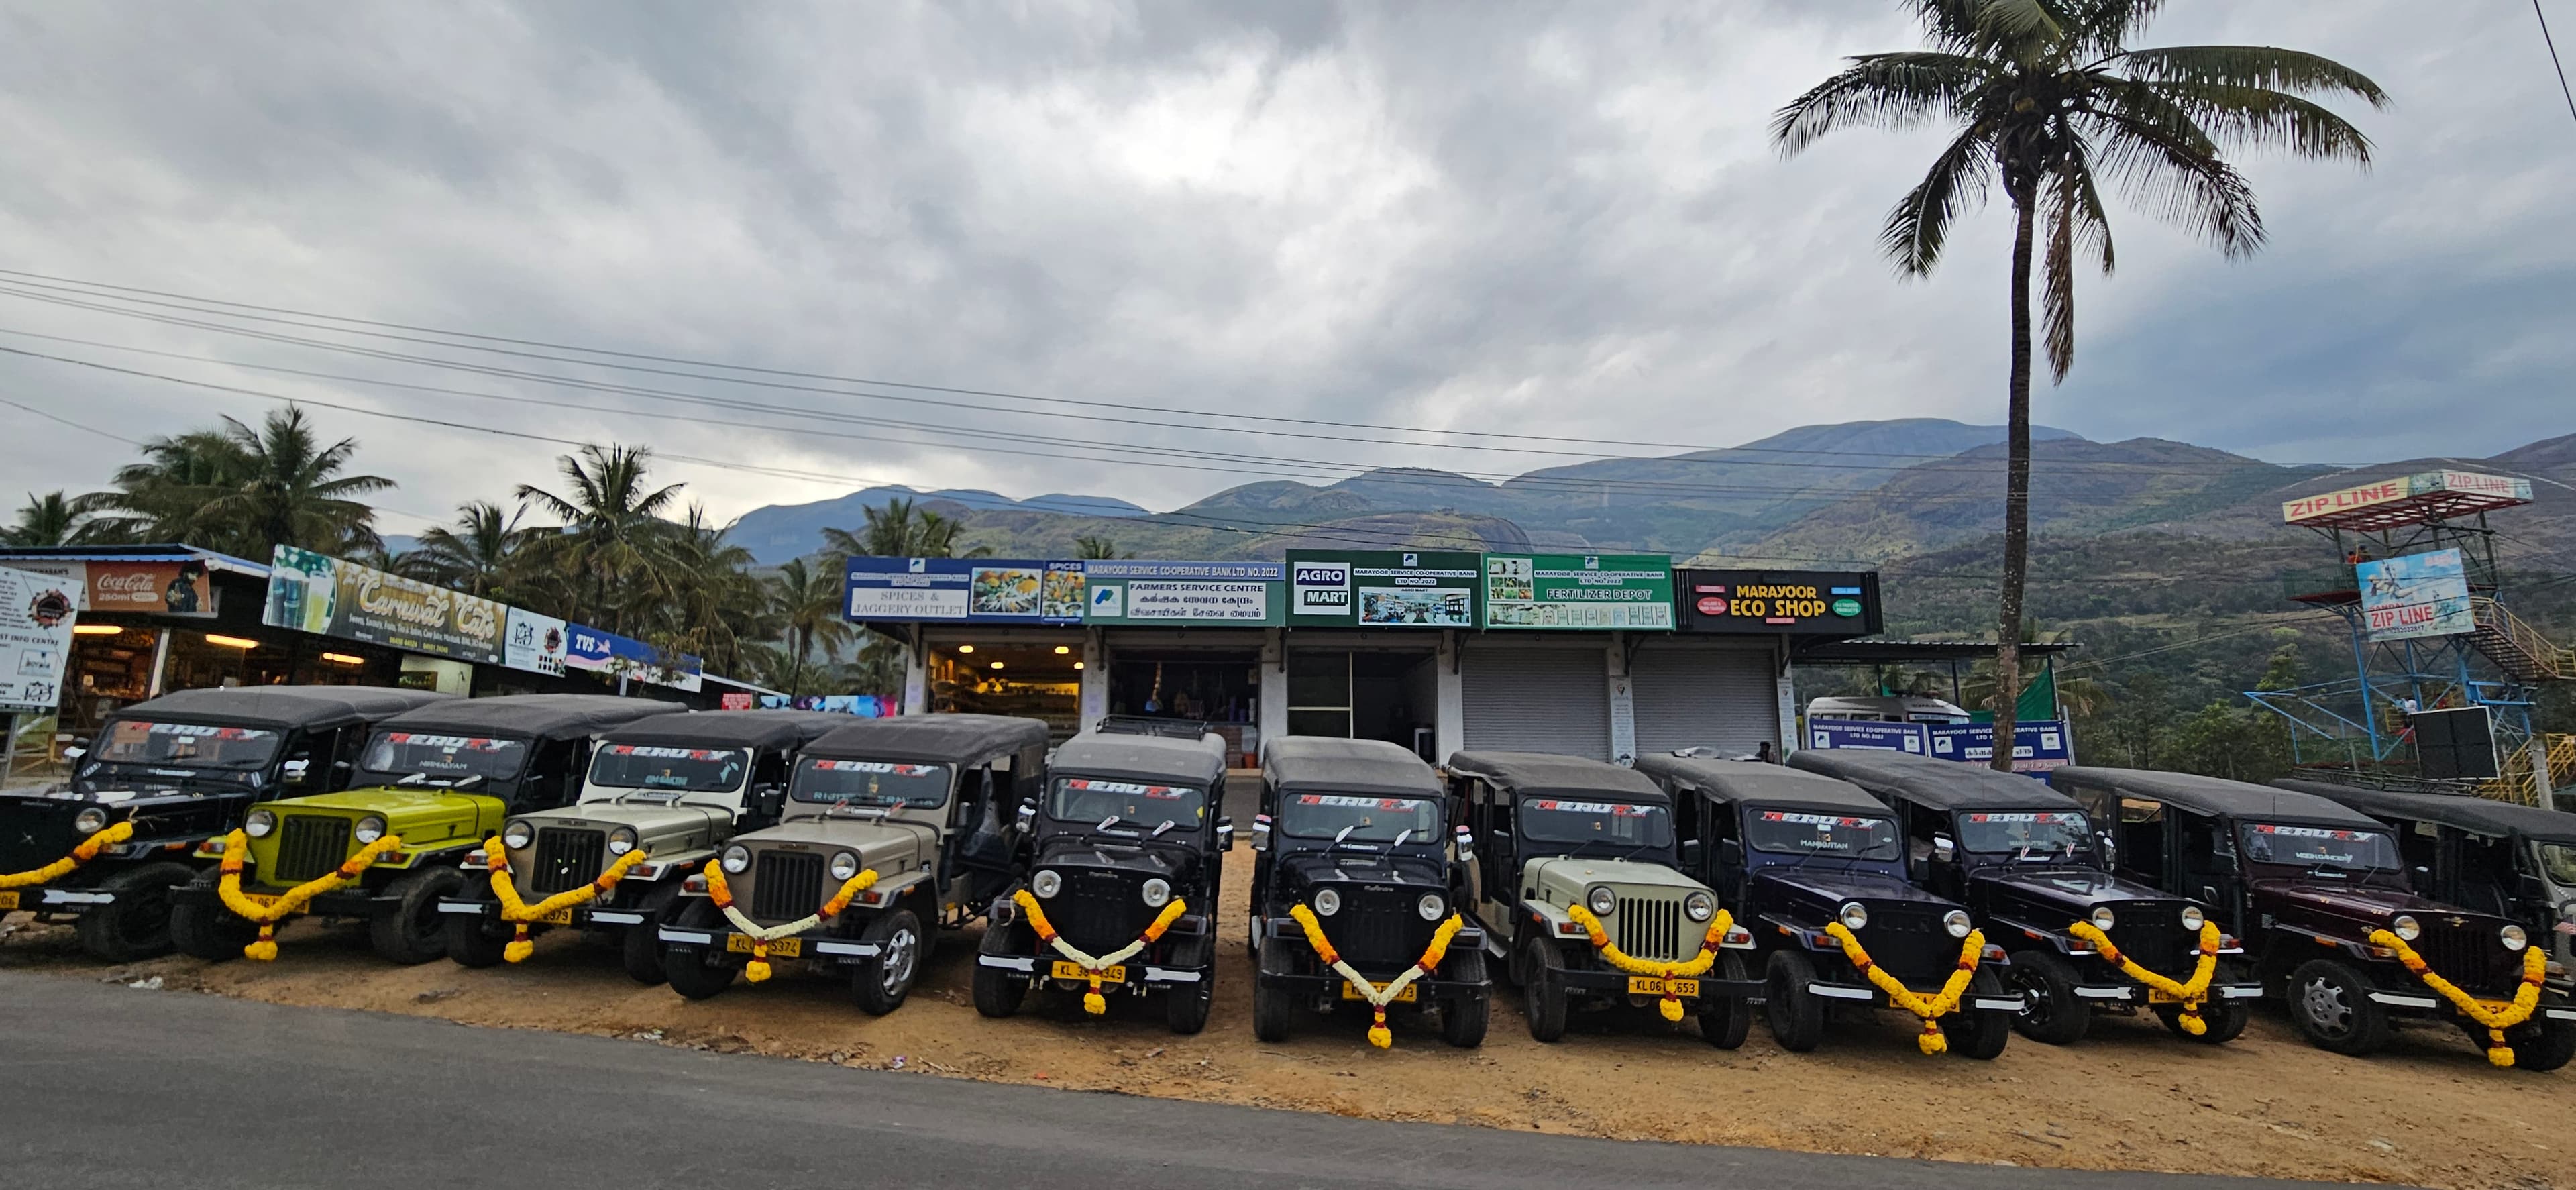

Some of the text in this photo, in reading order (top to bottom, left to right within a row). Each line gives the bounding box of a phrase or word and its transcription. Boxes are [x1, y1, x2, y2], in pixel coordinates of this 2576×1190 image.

[2448, 473, 2510, 494] ZIP LINE
[2290, 482, 2399, 517] ZIP LINE
[1087, 565, 1128, 574] MARAYOOR
[1130, 565, 1158, 575] SERVICE
[1160, 566, 1211, 576] CO-OPERATIVE
[1212, 567, 1232, 576] BANK
[1233, 567, 1245, 576] LTD
[1298, 571, 1343, 581] AGRO
[881, 592, 939, 602] SPICES &
[1307, 592, 1348, 602] MART
[1547, 590, 1652, 599] FERTILIZER DEPOT
[1737, 585, 1817, 598] MARAYOOR
[854, 604, 964, 615] JAGGERY OUTLET
[1730, 600, 1826, 617] ECO SHOP
[2371, 606, 2434, 628] ZIP LINE
[576, 634, 595, 652] TVS
[1061, 965, 1071, 976] KL
[1636, 980, 1647, 991] KL
[1650, 981, 1661, 991] 06
